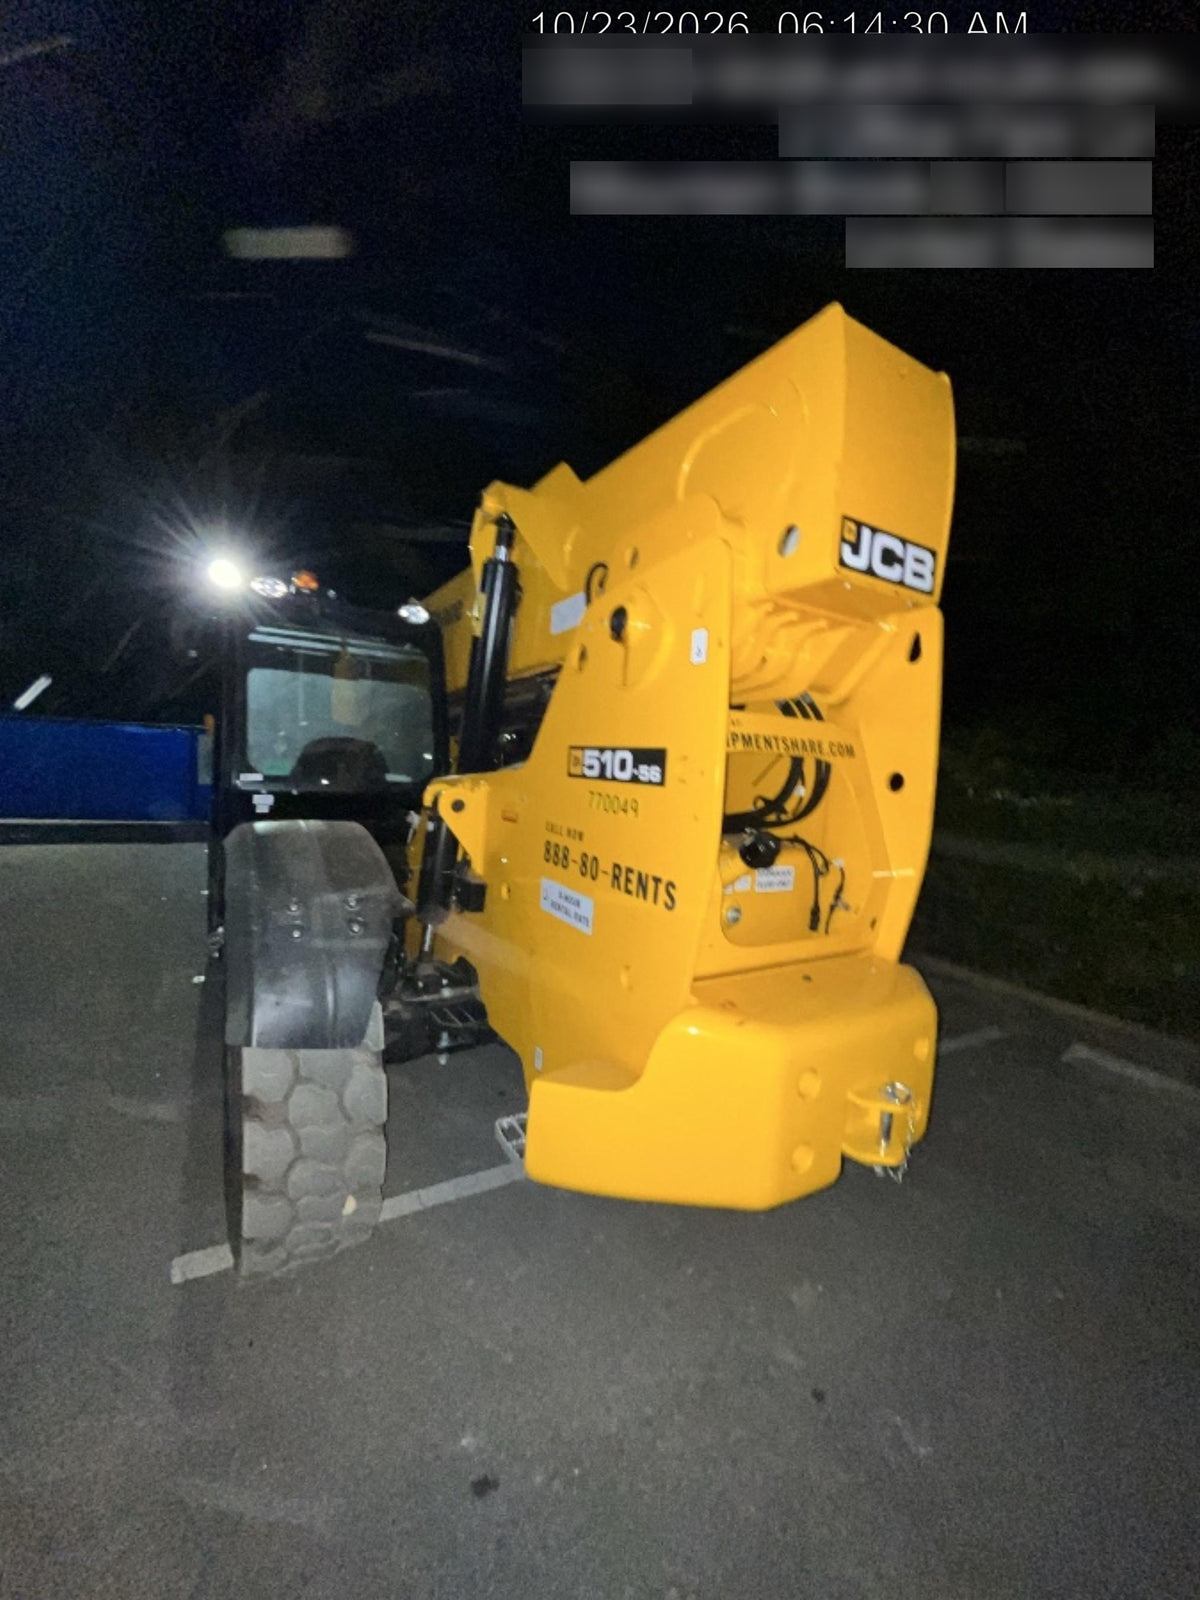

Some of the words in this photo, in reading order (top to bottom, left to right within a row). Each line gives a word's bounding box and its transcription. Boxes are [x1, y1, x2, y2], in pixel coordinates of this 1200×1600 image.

[841, 524, 934, 593] JCB
[588, 790, 639, 817] 770049
[543, 840, 677, 911] 888-80-RENTS
